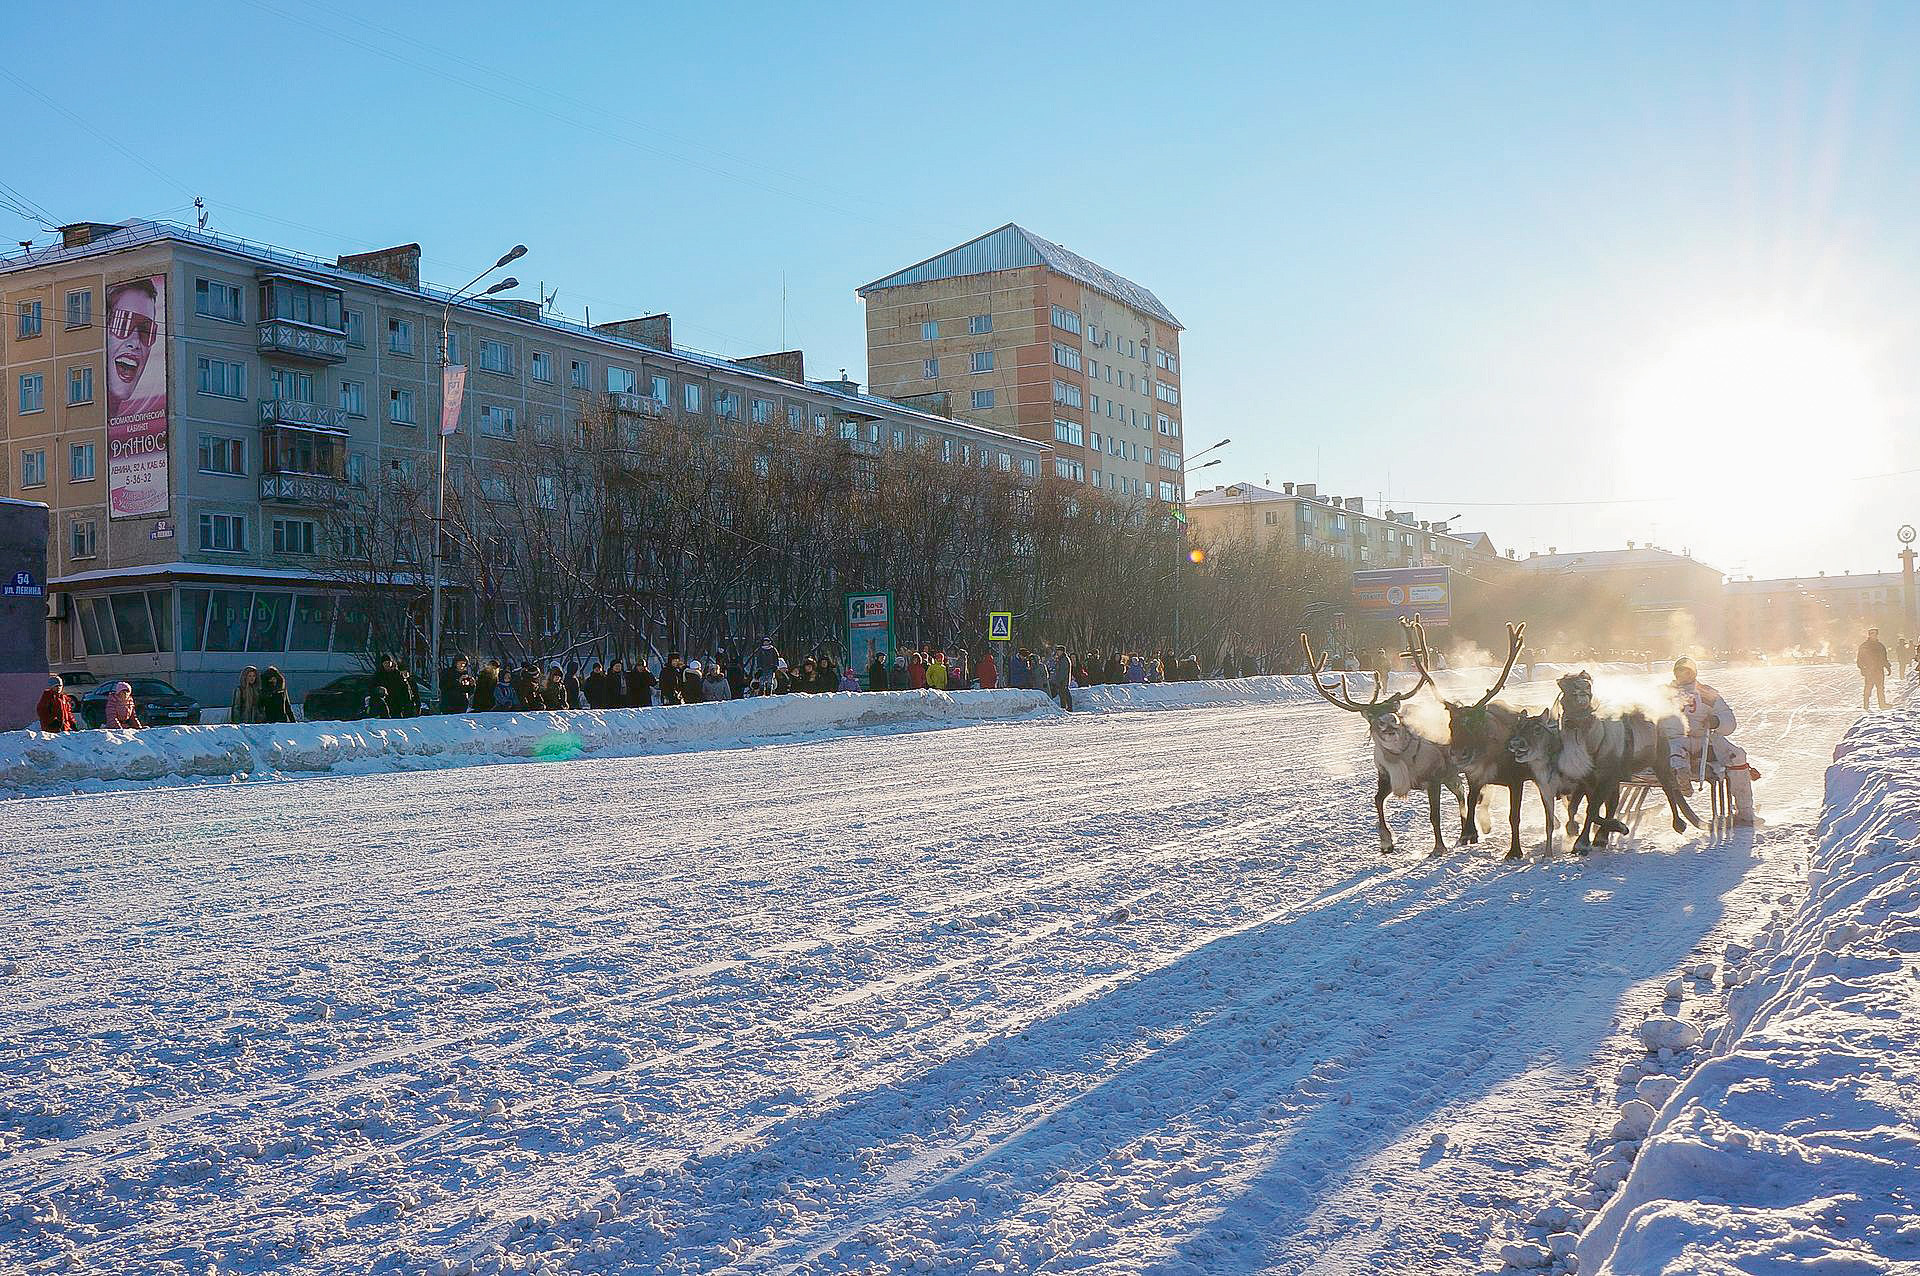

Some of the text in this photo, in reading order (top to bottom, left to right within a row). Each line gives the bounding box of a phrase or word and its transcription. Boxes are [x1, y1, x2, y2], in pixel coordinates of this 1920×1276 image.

[127, 422, 149, 432] КАБИНЕТ
[133, 463, 140, 472] 52
[126, 473, 152, 485] 5-36-32
[158, 521, 166, 530] 52
[17, 573, 29, 584] 54
[16, 586, 41, 595] ЛЕНИНА
[852, 600, 865, 618] Я
